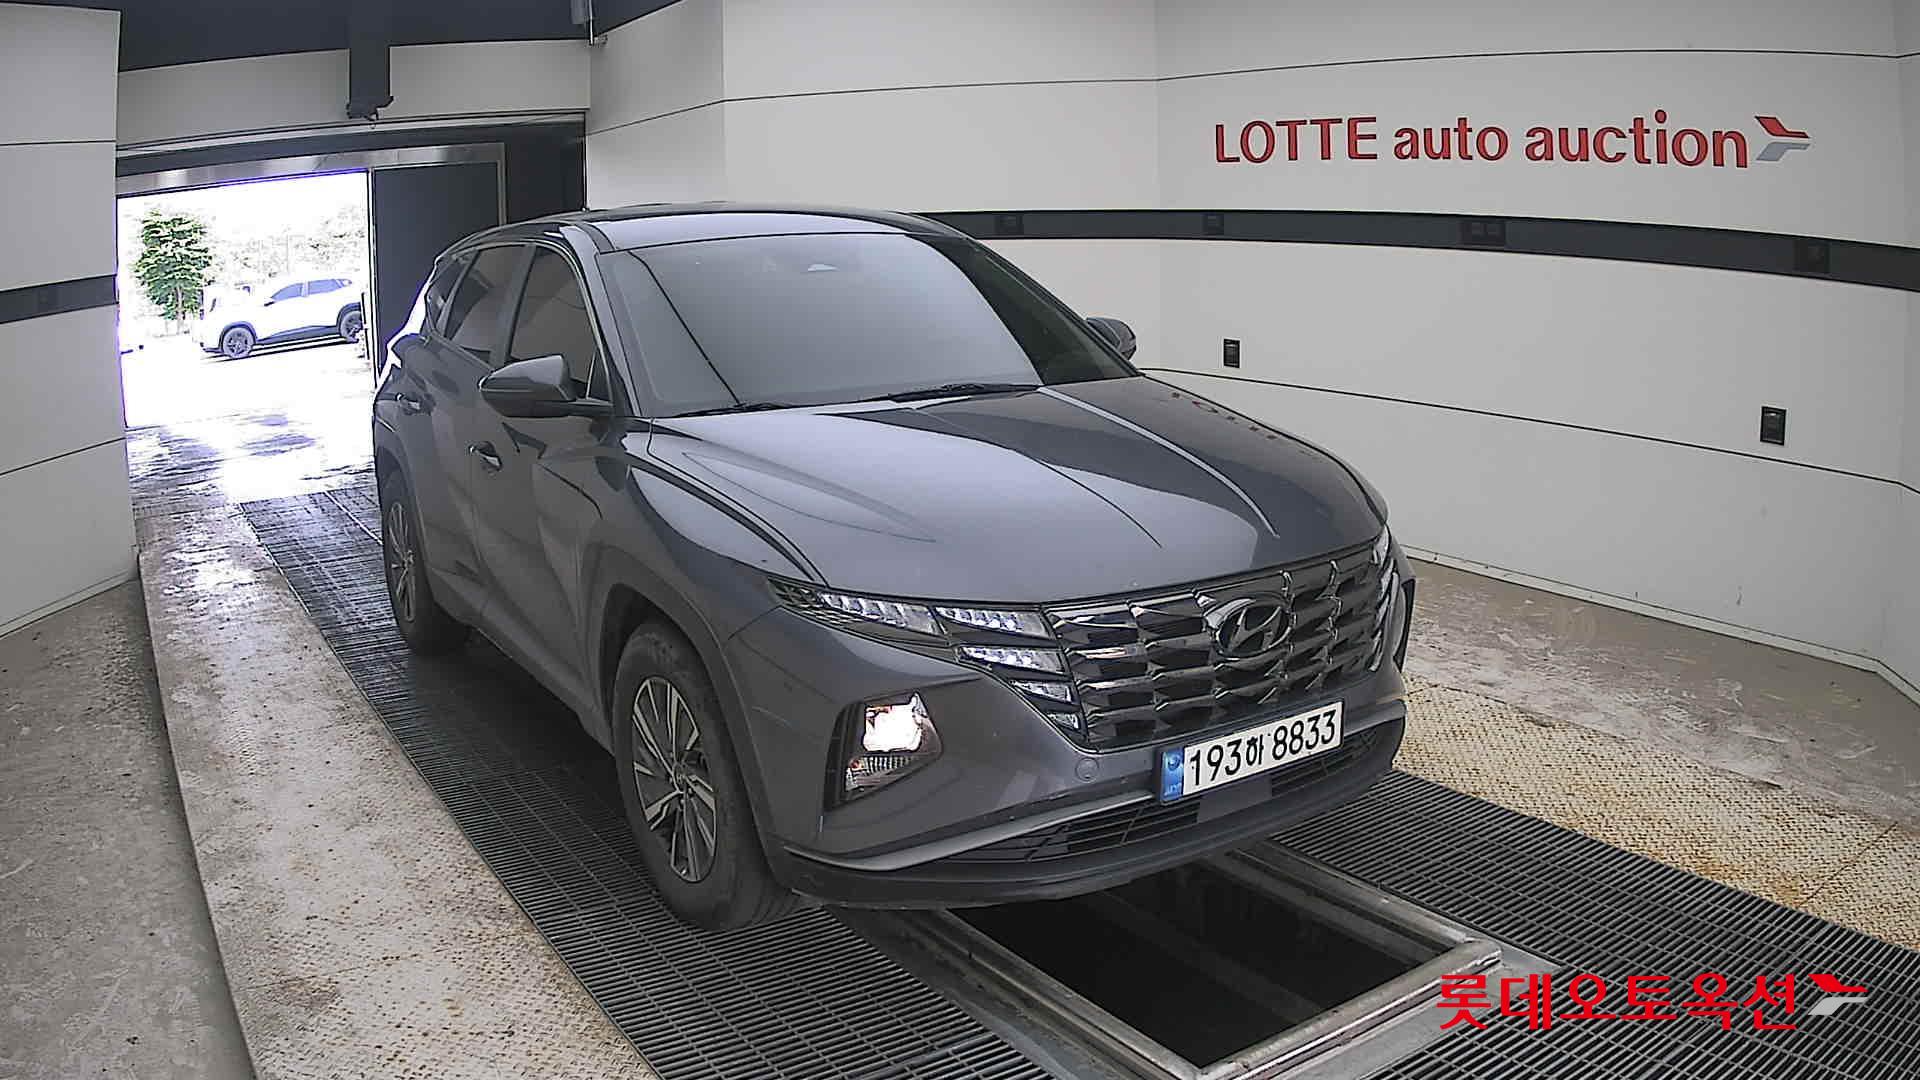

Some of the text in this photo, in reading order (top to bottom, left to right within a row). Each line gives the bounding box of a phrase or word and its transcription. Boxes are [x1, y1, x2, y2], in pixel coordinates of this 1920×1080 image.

[1214, 109, 1748, 169] LOTTE auto auction
[1189, 709, 1337, 786] 193하 8833
